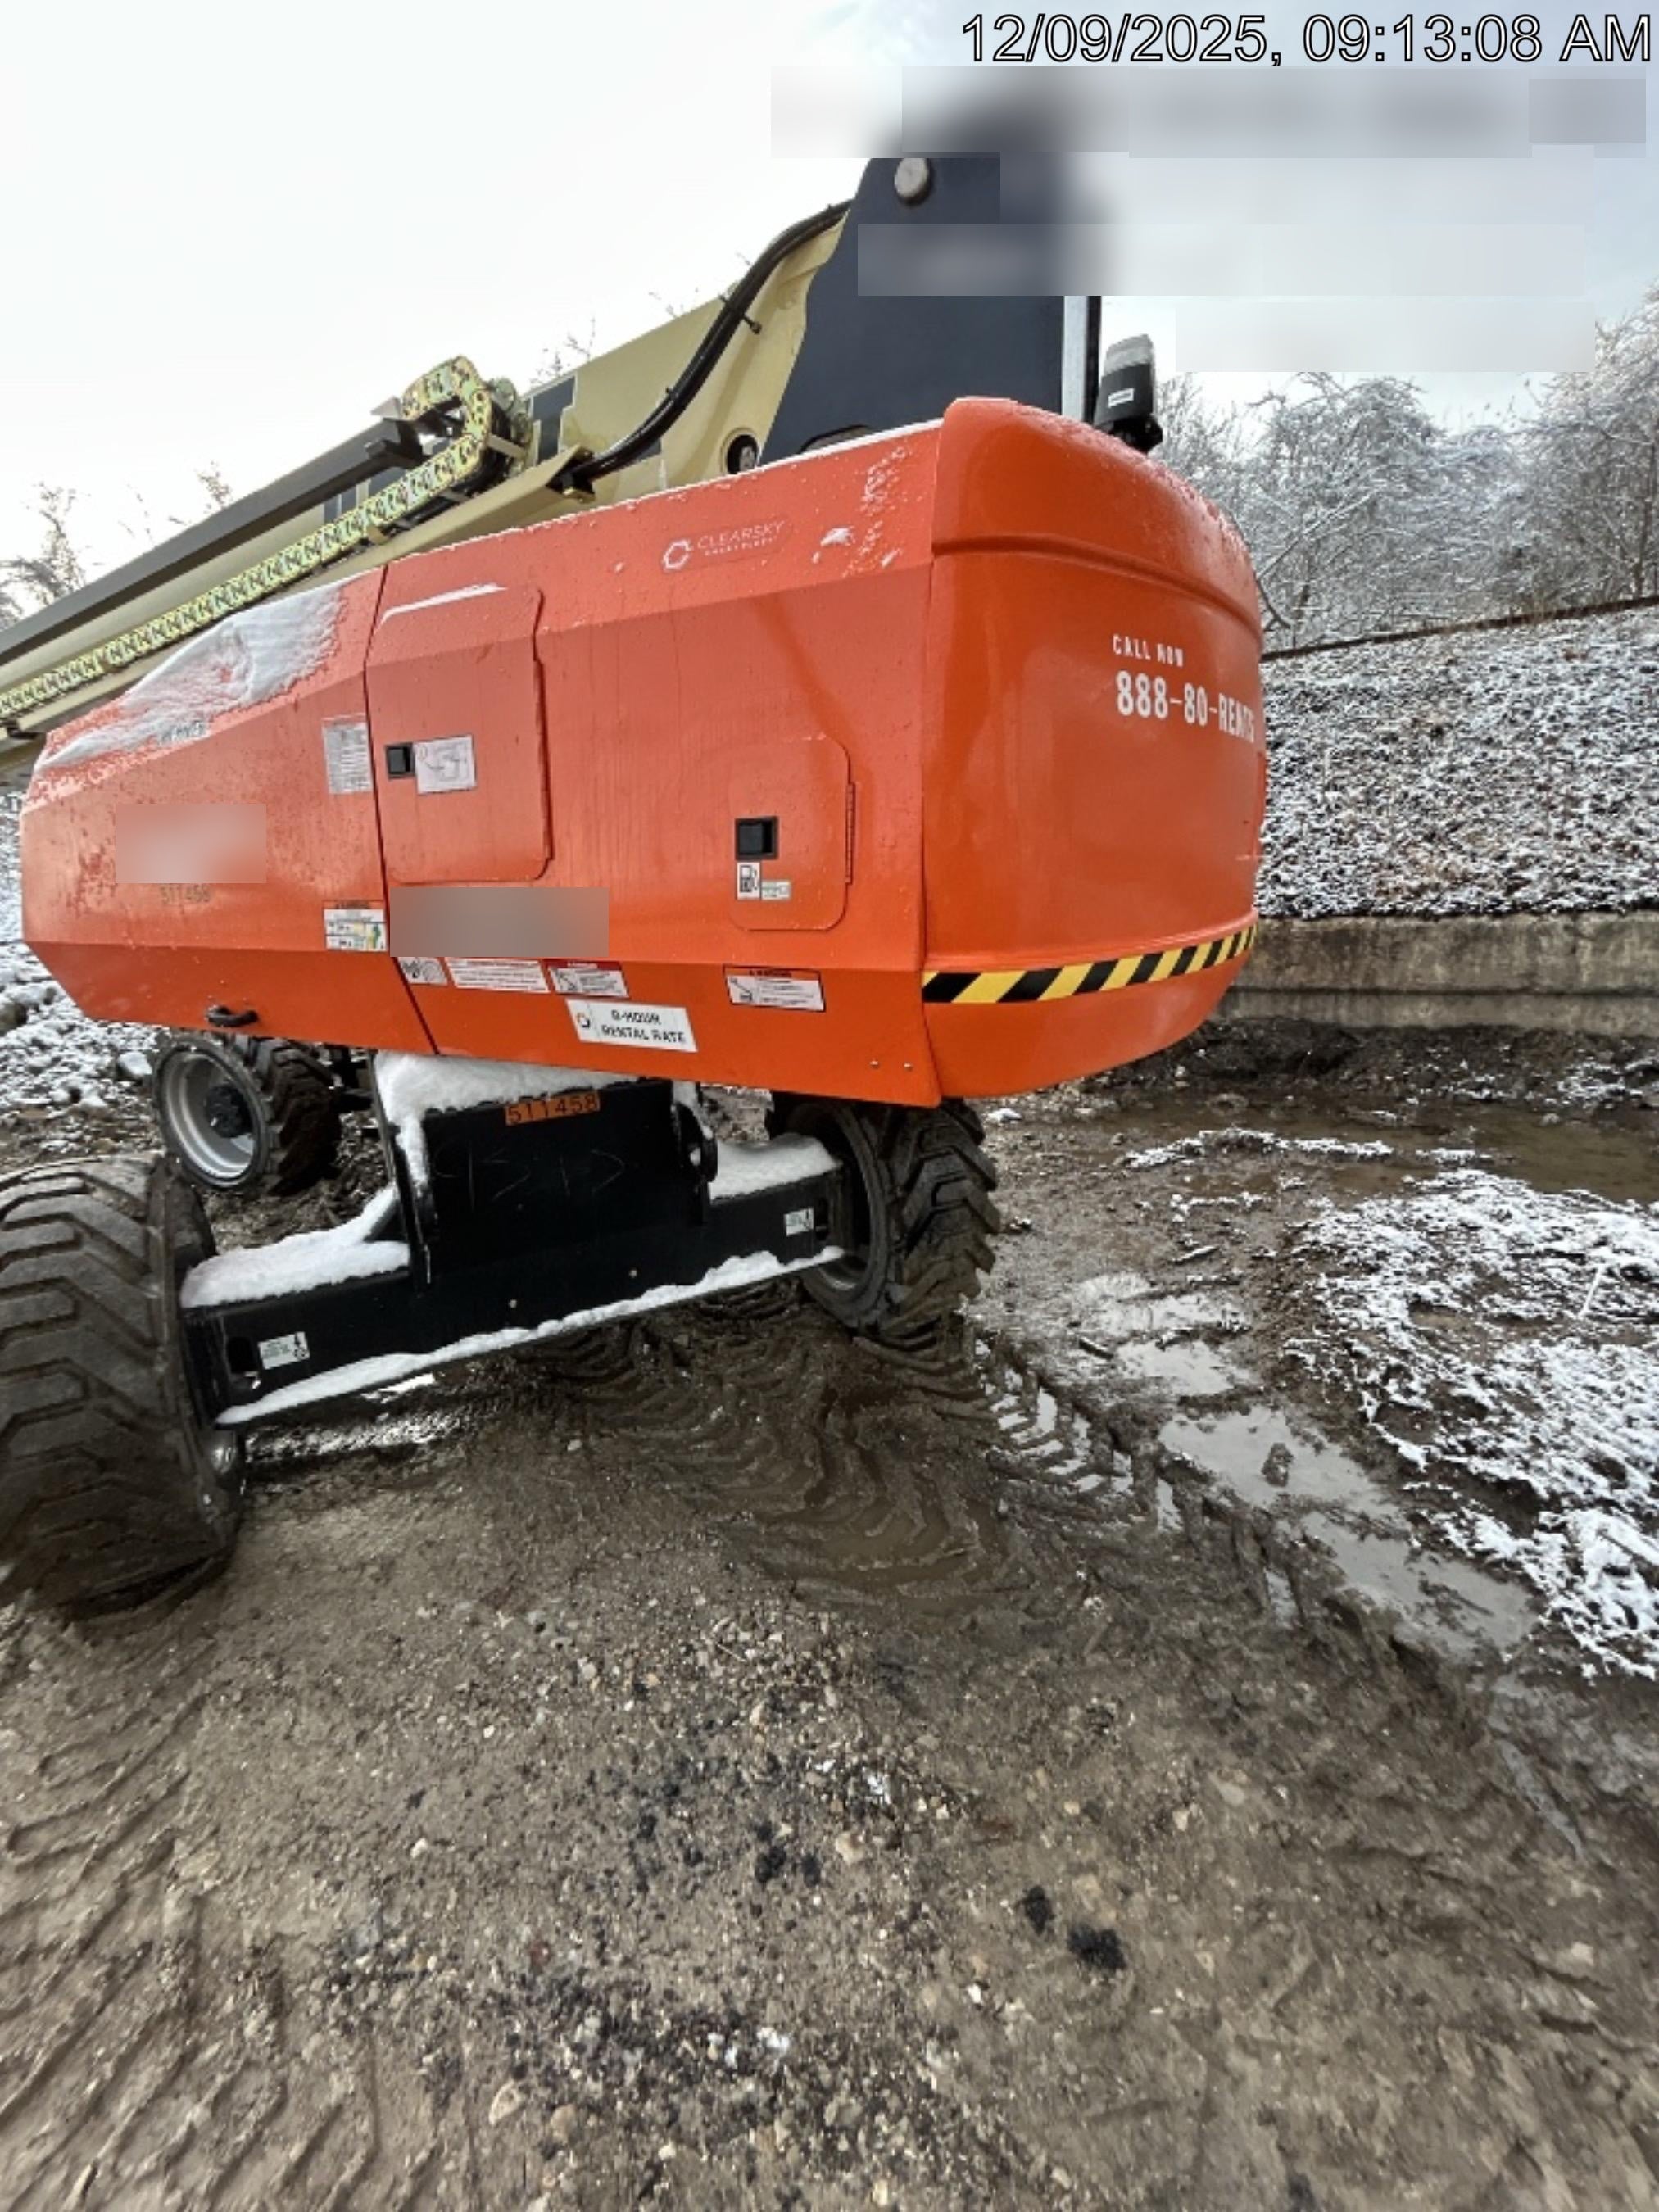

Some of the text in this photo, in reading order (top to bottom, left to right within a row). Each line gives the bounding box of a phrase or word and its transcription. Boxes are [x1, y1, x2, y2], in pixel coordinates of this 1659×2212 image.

[697, 520, 786, 550] CLEARSKY
[1113, 633, 1151, 660] CALL
[601, 1024, 686, 1044] RENTAL RATE
[507, 1094, 597, 1124] 511458
